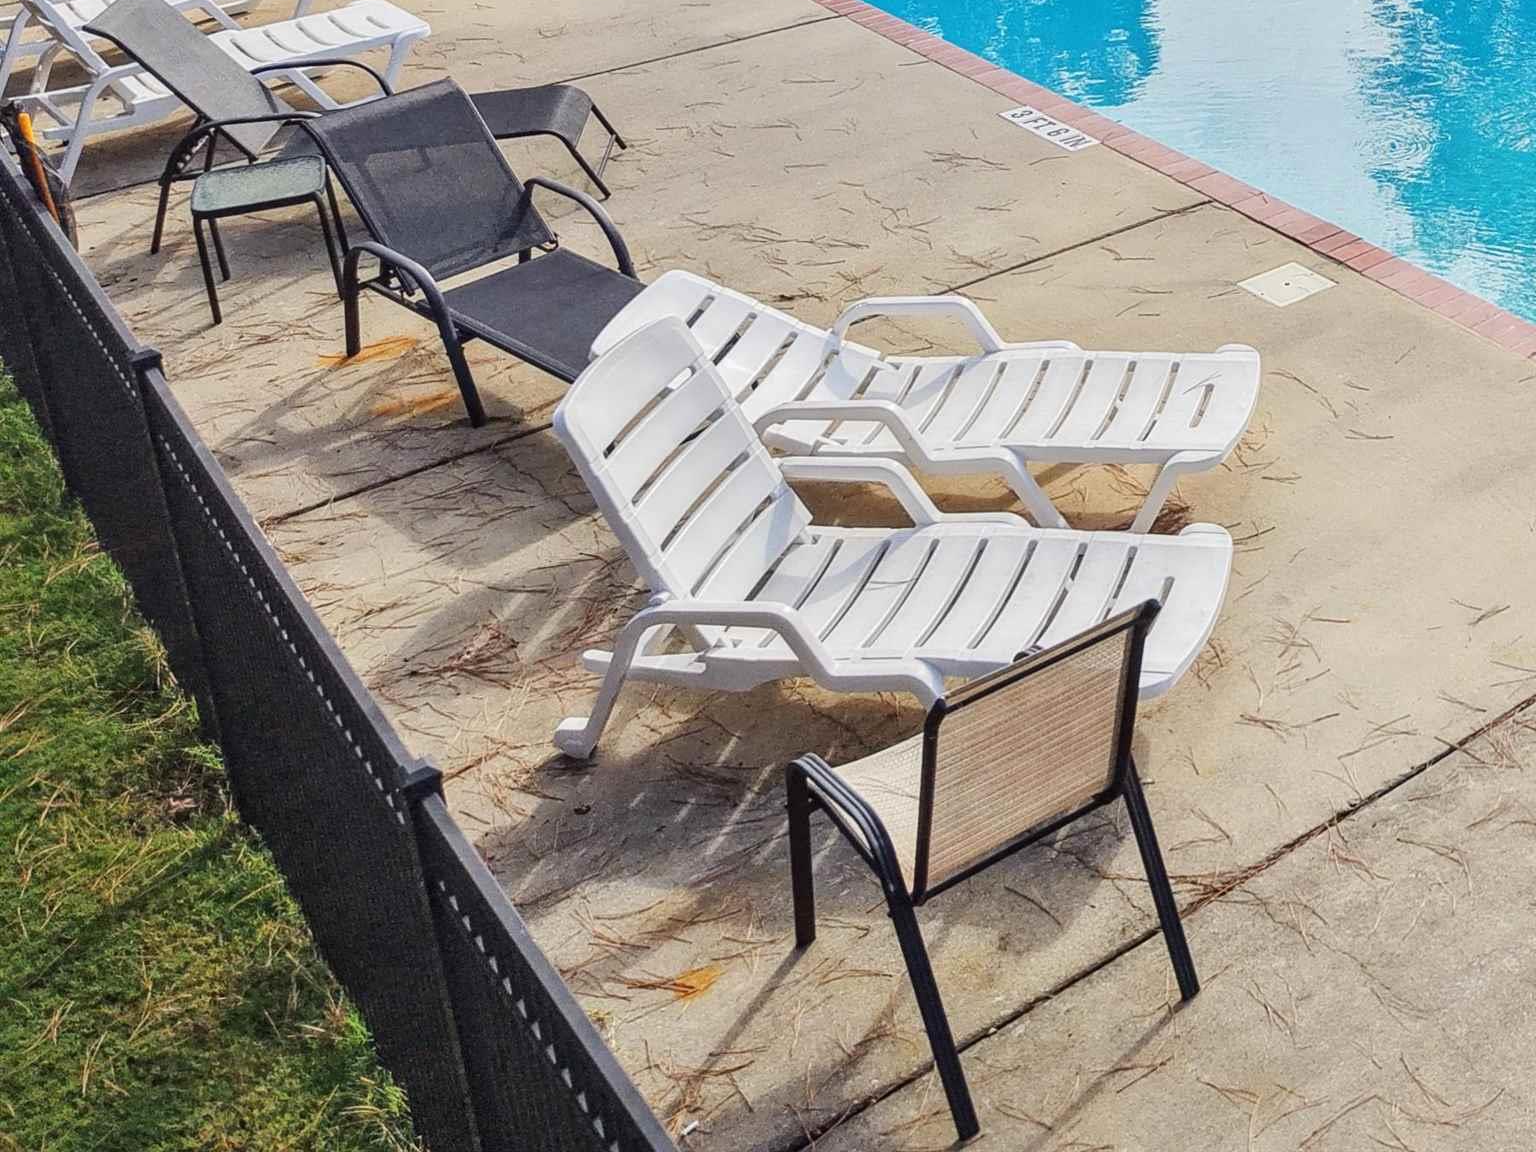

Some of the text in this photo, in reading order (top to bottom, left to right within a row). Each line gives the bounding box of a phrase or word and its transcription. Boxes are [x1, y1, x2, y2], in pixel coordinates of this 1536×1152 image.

[1011, 110, 1092, 147] 3 FT 6 IN
